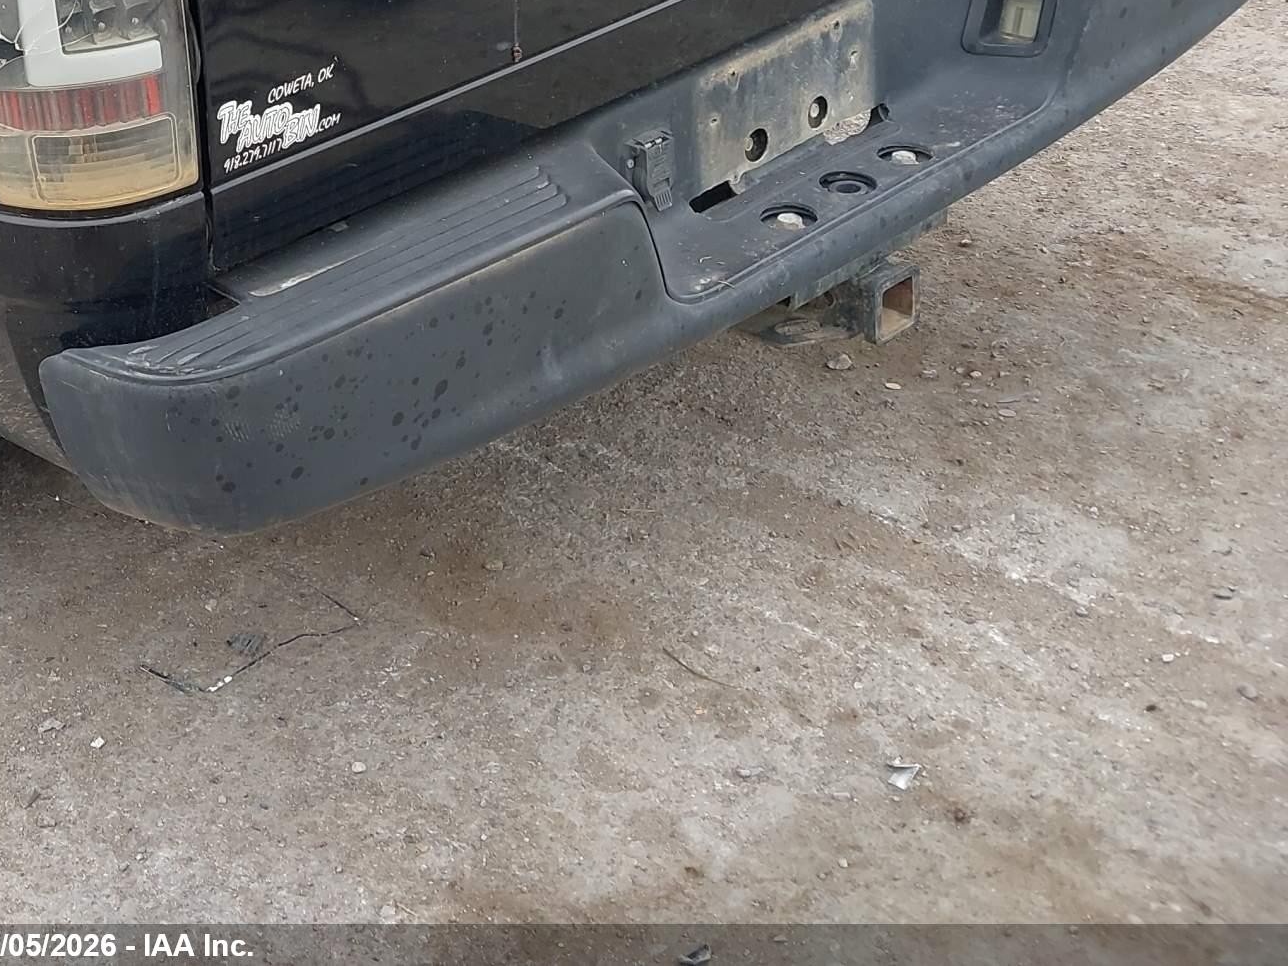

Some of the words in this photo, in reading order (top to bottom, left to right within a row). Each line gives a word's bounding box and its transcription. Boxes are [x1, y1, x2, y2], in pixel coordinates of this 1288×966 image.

[268, 72, 315, 104] COWETA,
[317, 62, 335, 84] OK
[217, 100, 252, 144] THE
[236, 102, 293, 153] AUTO
